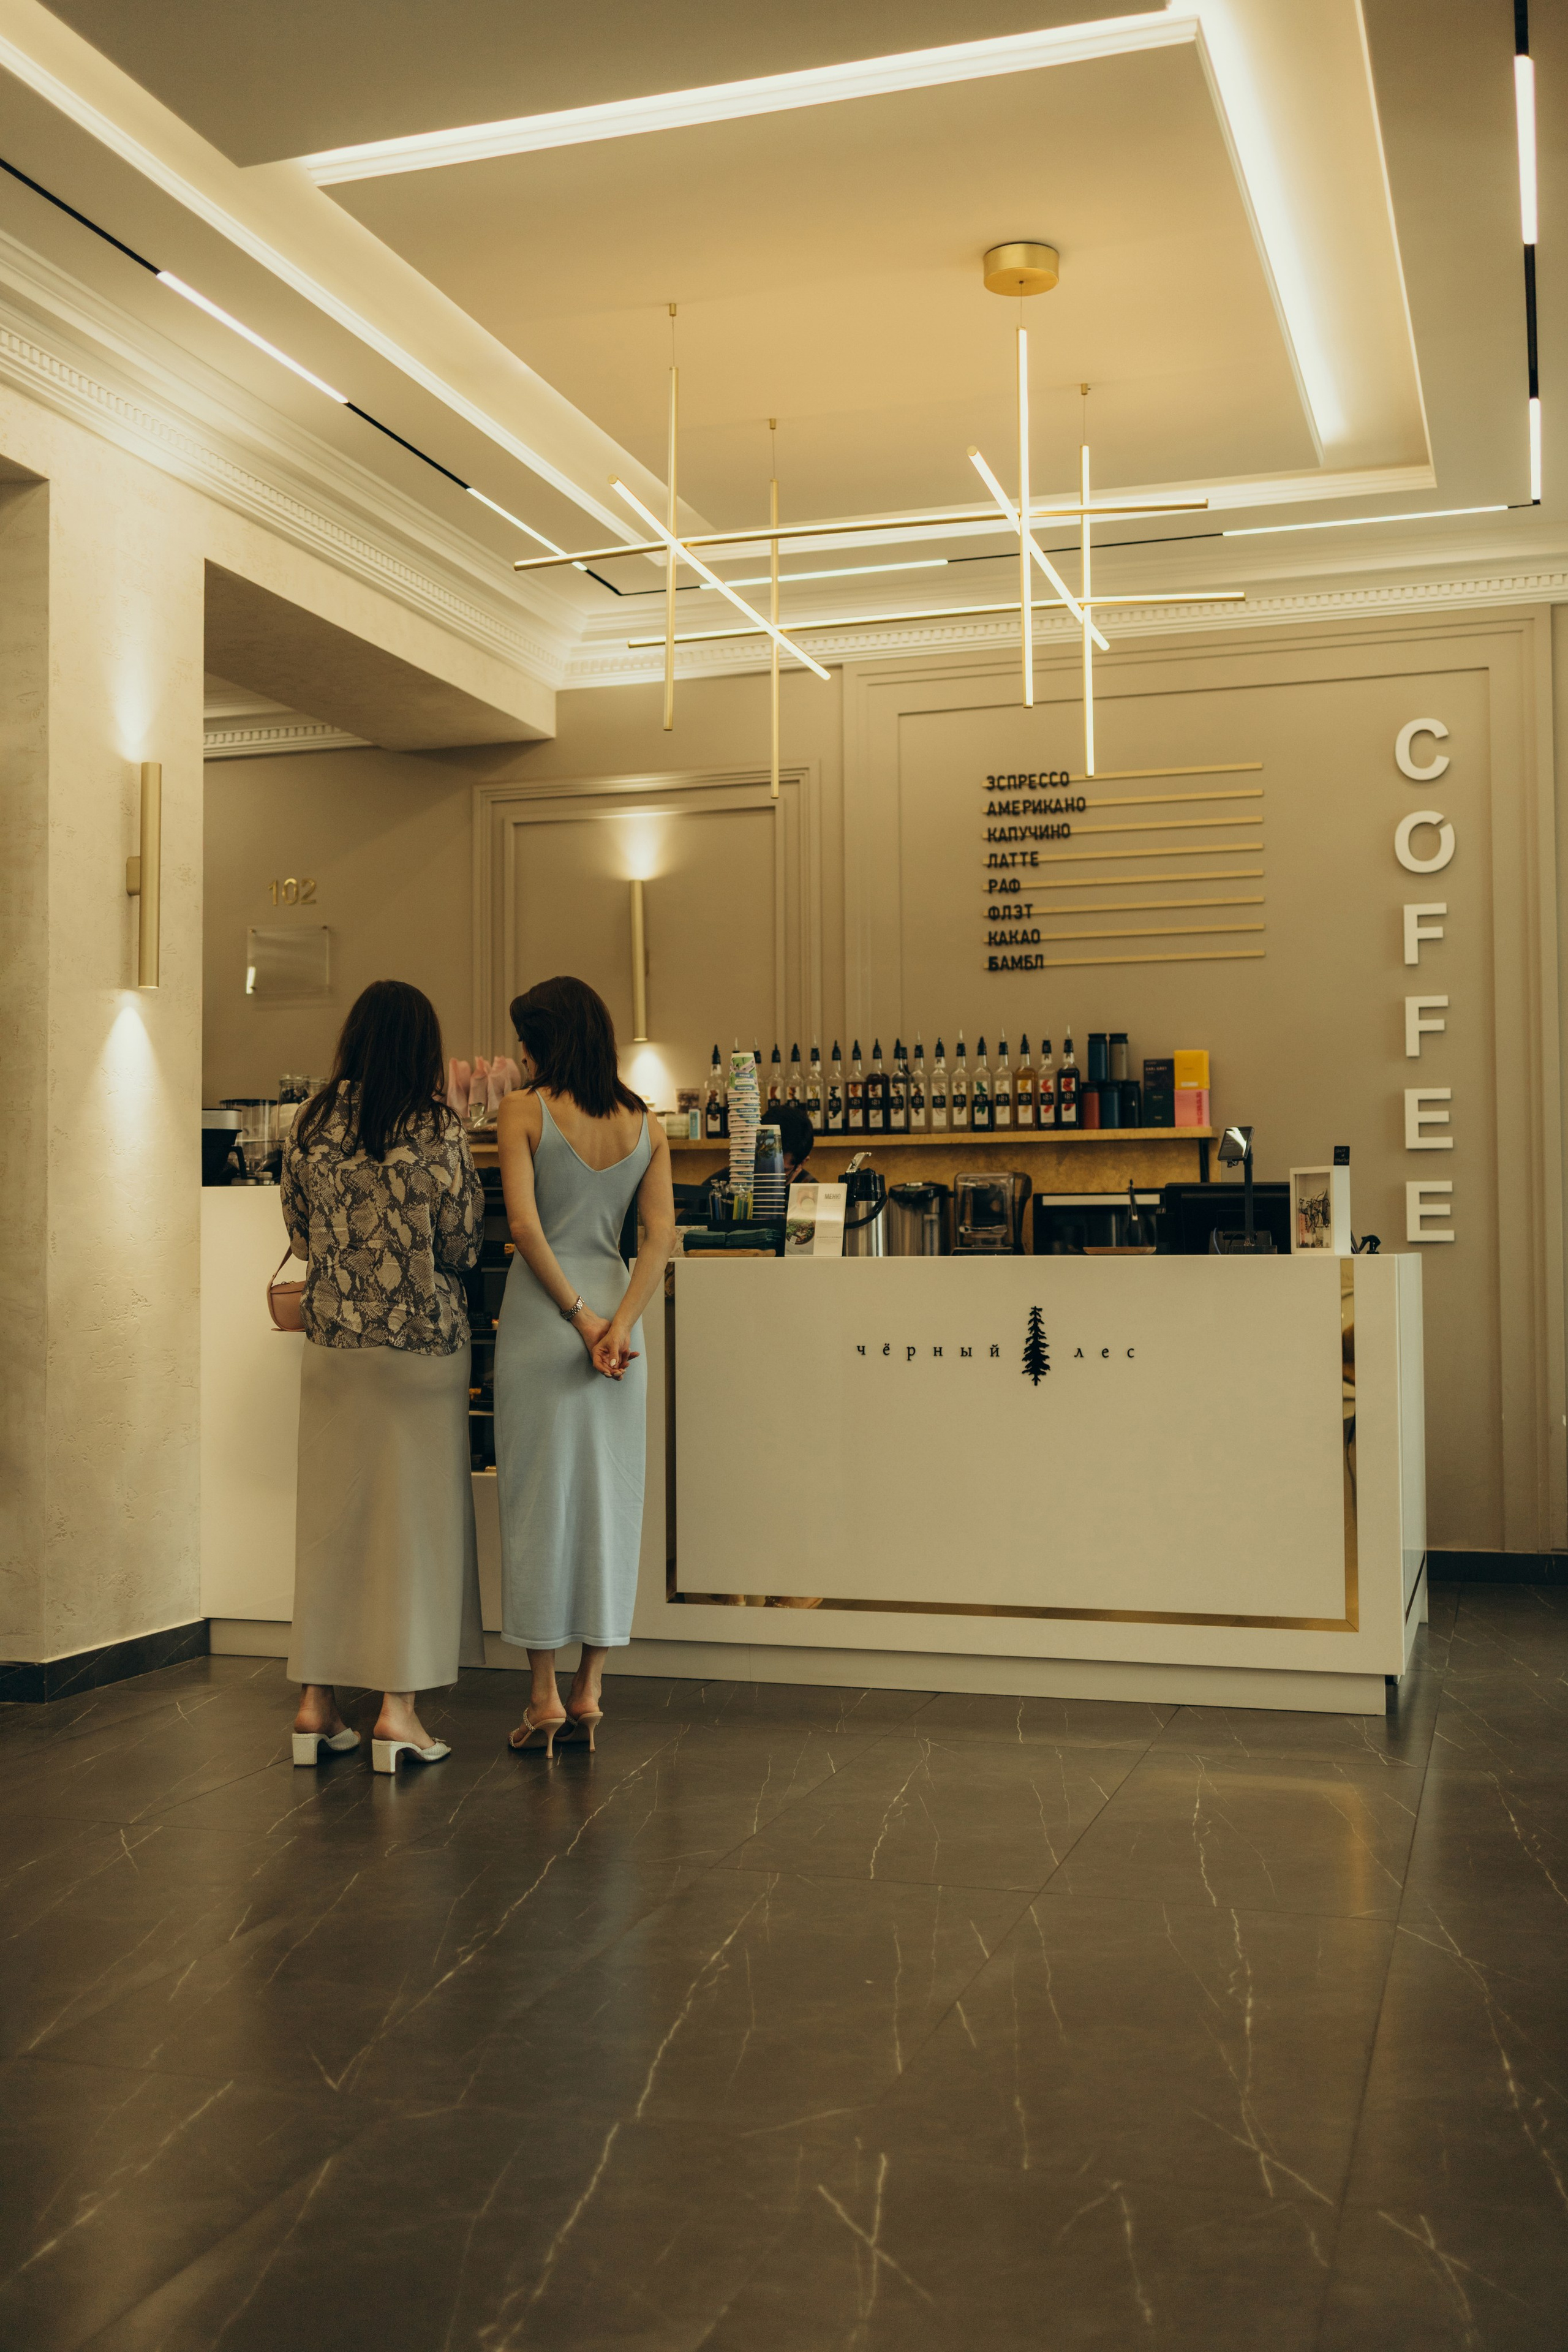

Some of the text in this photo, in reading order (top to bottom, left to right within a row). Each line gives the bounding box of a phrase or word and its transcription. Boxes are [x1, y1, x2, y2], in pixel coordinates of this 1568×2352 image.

[987, 772, 1069, 790] ЭСПРЕССО
[987, 797, 1086, 816] АМЕРИКАНО
[987, 824, 1071, 842] КАПУЧИНО
[987, 851, 1039, 868] ЛАТТЕ
[268, 878, 316, 905] 102
[988, 879, 1020, 894] РАФ
[987, 904, 1032, 921] ФЛЭТ
[987, 929, 1041, 946] КАКАО
[987, 954, 1044, 972] БАМБЛ
[1395, 718, 1455, 1242] COFFEE
[857, 1343, 1134, 1361] чёрный лес
